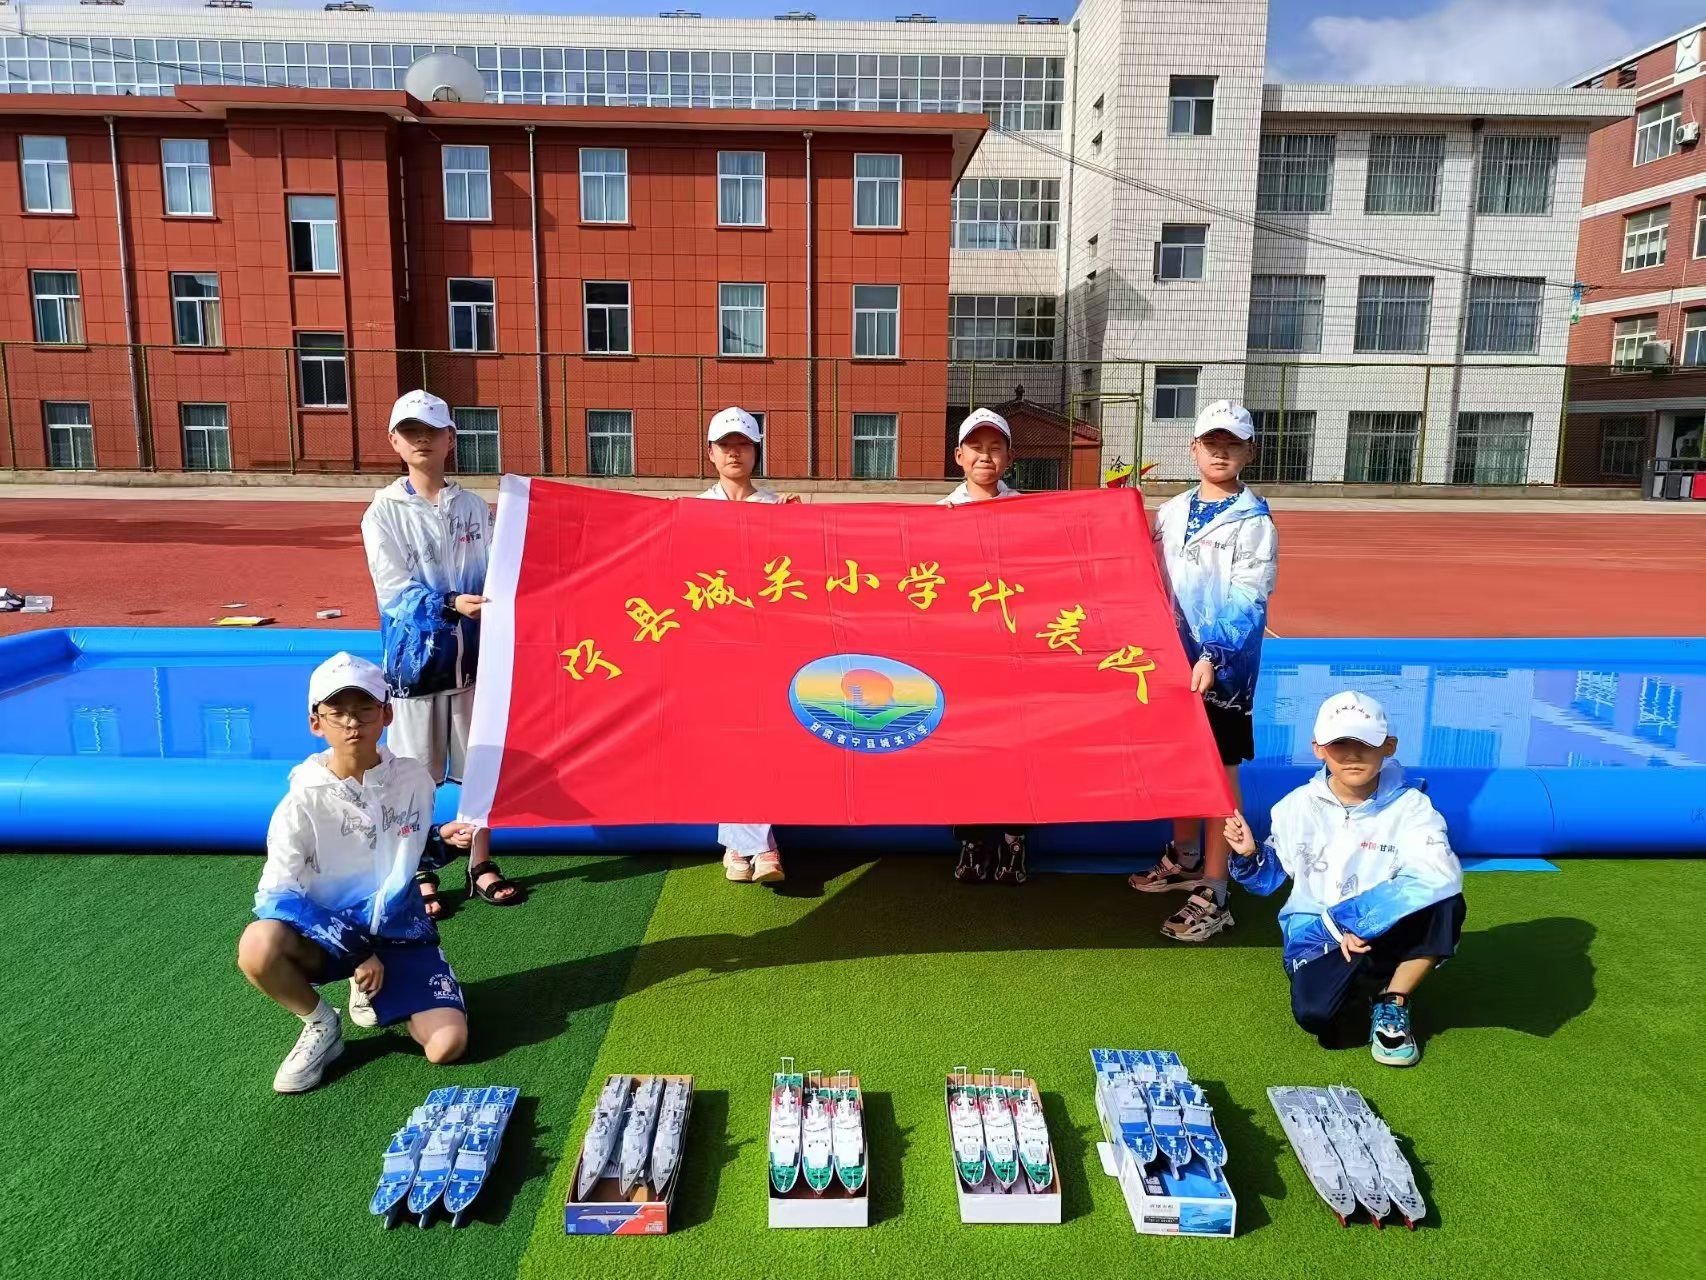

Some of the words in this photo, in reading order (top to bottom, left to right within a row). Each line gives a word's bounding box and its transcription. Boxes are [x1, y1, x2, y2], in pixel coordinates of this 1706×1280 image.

[560, 555, 1156, 704] 宁县城关小学代表队
[810, 721, 929, 749] 甘肃省宁县城关小学
